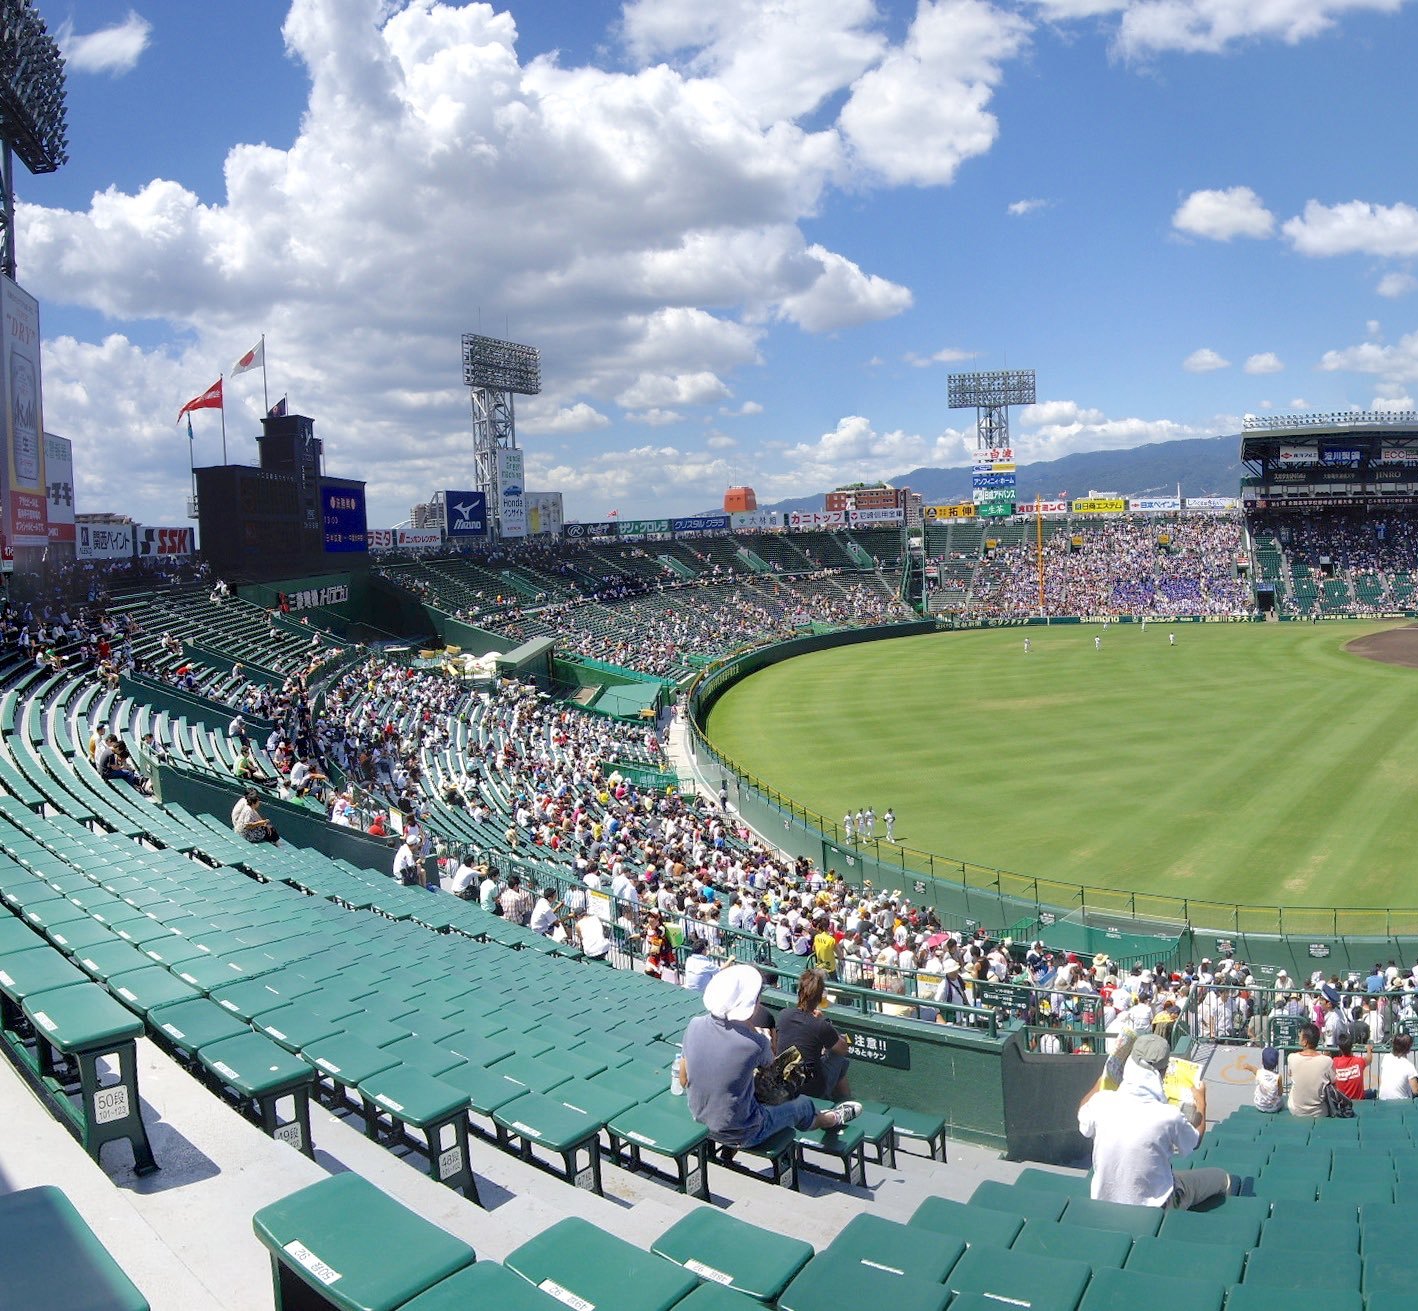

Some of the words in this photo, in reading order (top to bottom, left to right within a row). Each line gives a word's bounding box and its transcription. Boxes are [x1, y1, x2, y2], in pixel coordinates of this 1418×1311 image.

[1384, 451, 1406, 459] ECC
[1374, 471, 1401, 480] JINRO
[503, 498, 523, 508] Honda
[1018, 502, 1066, 513] オロナミンC
[1140, 501, 1180, 509] 日本ペイント
[503, 508, 523, 518] インサイト
[859, 510, 903, 520] 尼崎信用金庫
[948, 506, 972, 517] 拓伸
[750, 513, 778, 525] 大林組
[790, 512, 843, 525] カニトップ
[618, 520, 669, 534] サン・クロレラ
[92, 530, 130, 551] 関西ペイント
[157, 529, 188, 554] SSK
[98, 1090, 125, 1111] 50段
